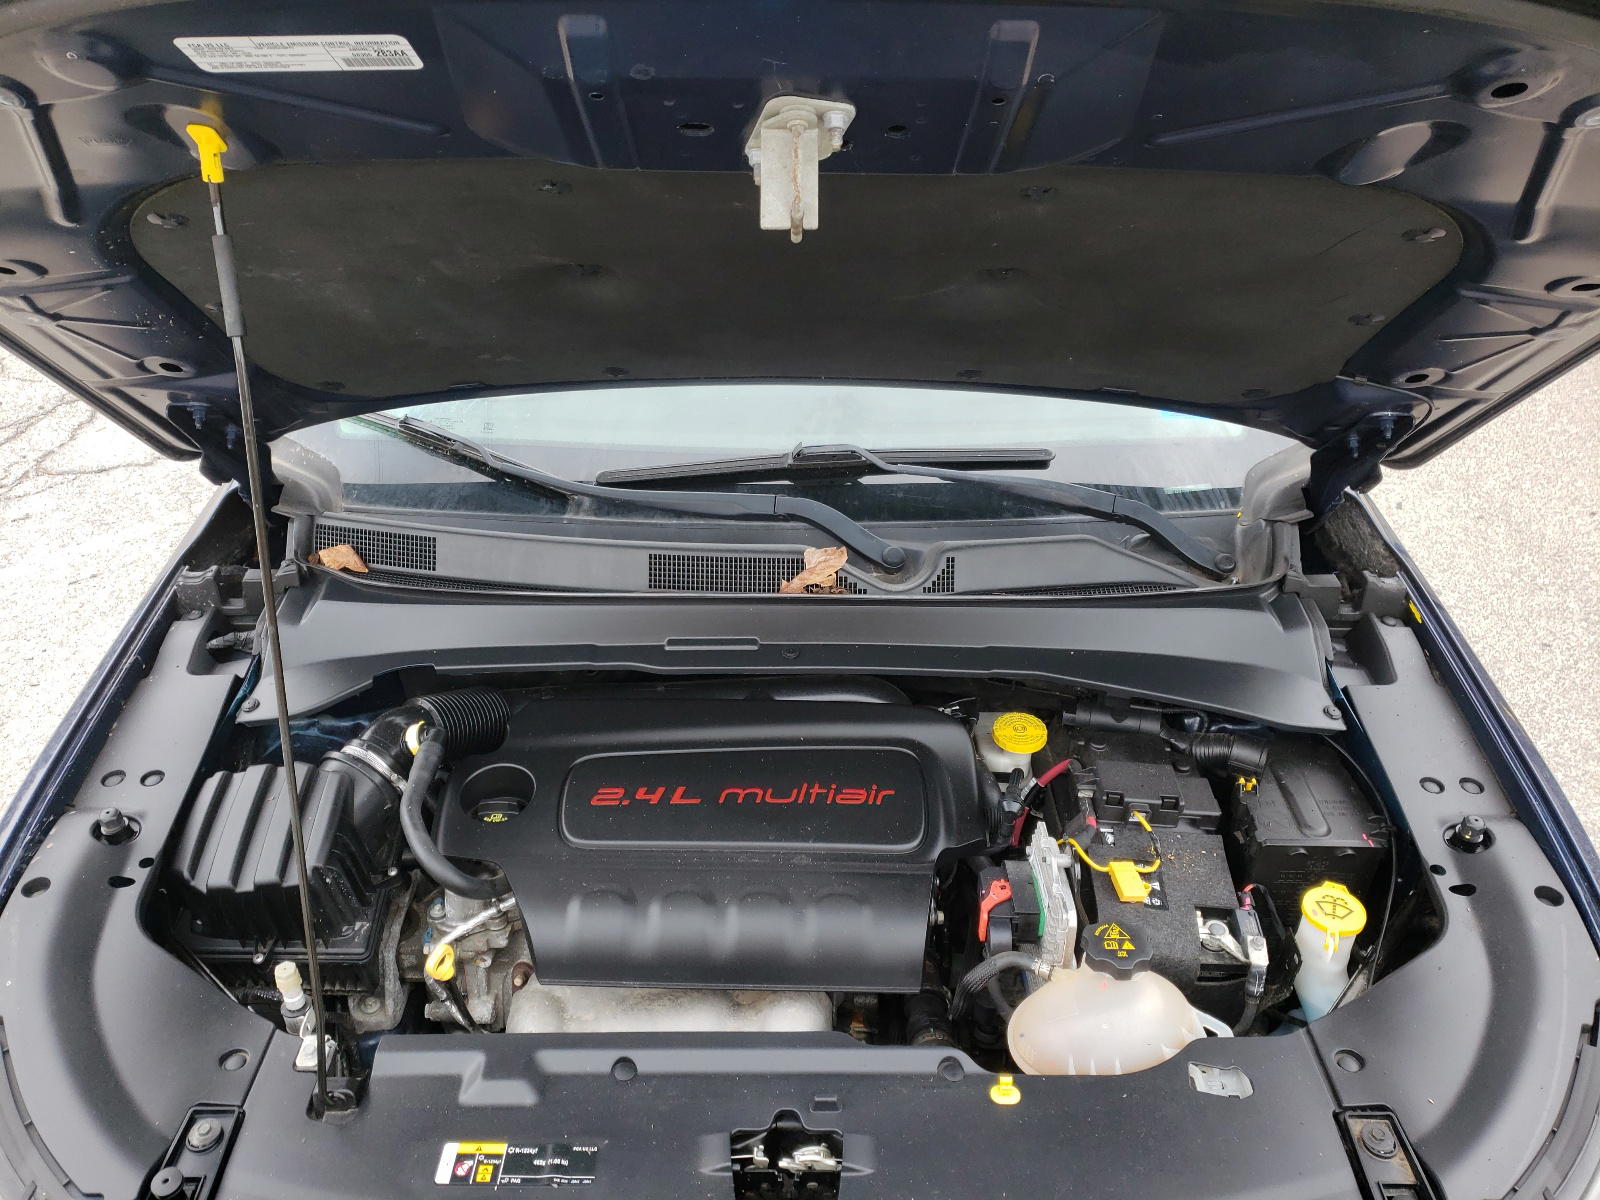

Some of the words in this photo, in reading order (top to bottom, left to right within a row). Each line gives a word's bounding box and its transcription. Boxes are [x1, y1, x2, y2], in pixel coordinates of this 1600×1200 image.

[374, 49, 408, 57] 283AA
[590, 785, 701, 806] 2.4L
[718, 783, 895, 805] multiair
